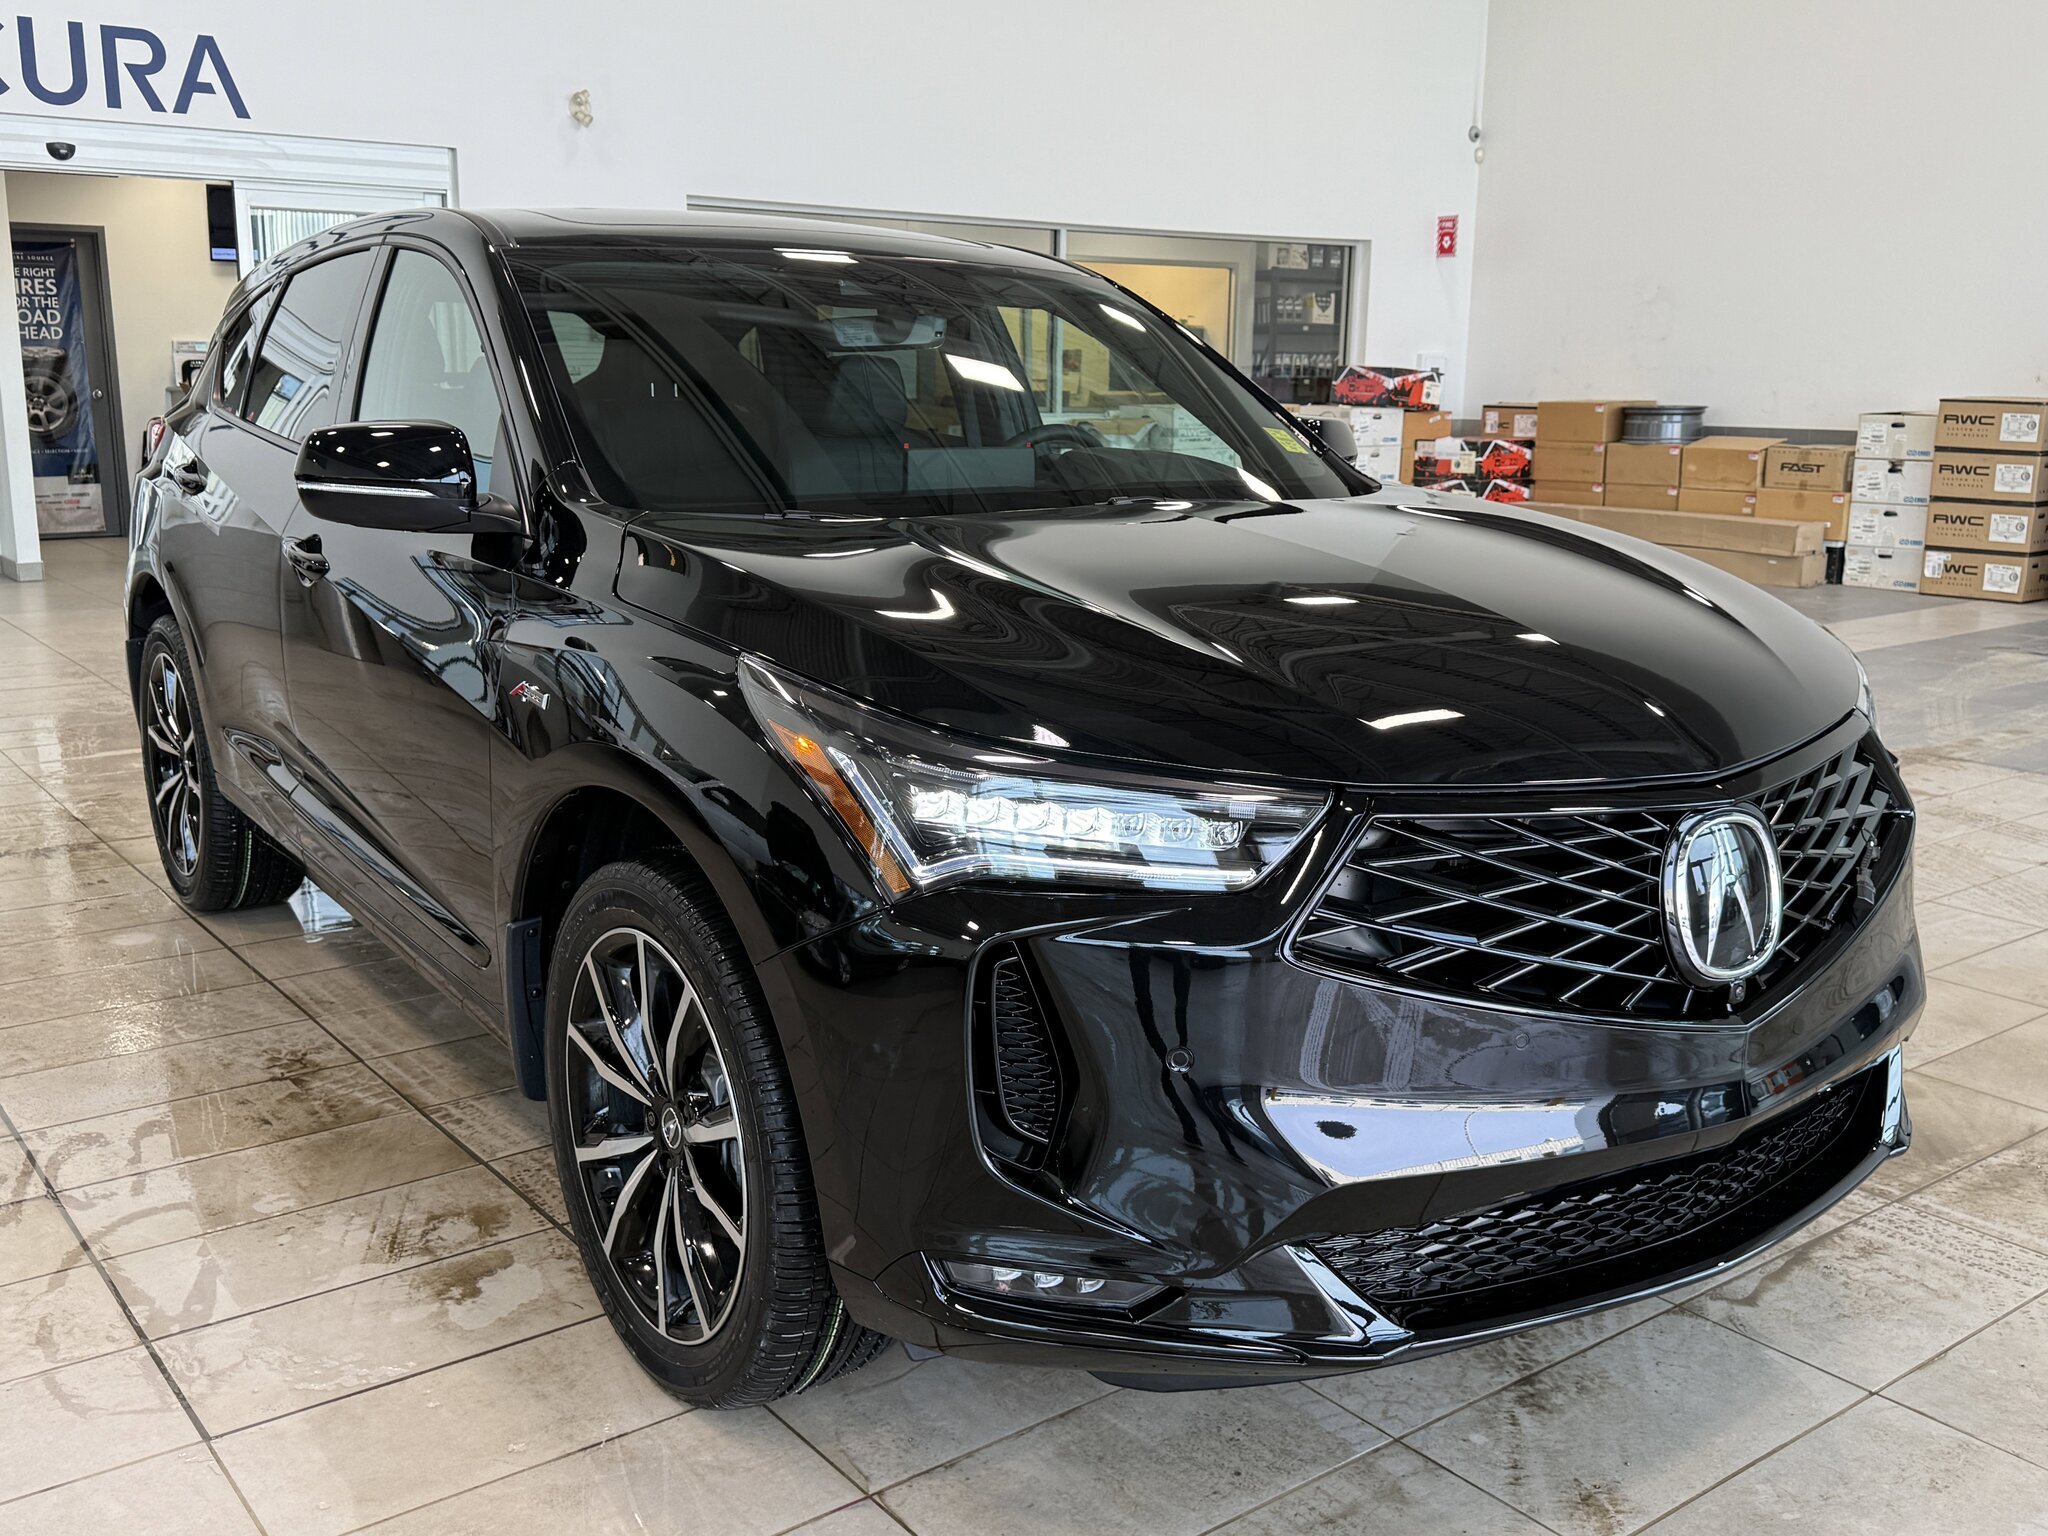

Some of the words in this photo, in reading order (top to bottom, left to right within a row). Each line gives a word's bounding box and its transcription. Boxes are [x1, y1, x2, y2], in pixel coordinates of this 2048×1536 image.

[0, 15, 251, 119] URA
[23, 267, 56, 277] RIGHT
[15, 278, 58, 296] IRES
[32, 296, 60, 308] THE
[18, 308, 62, 325] OAD
[20, 326, 64, 340] HEAD
[1780, 462, 1826, 474] FAST
[1942, 563, 1979, 576] WC
